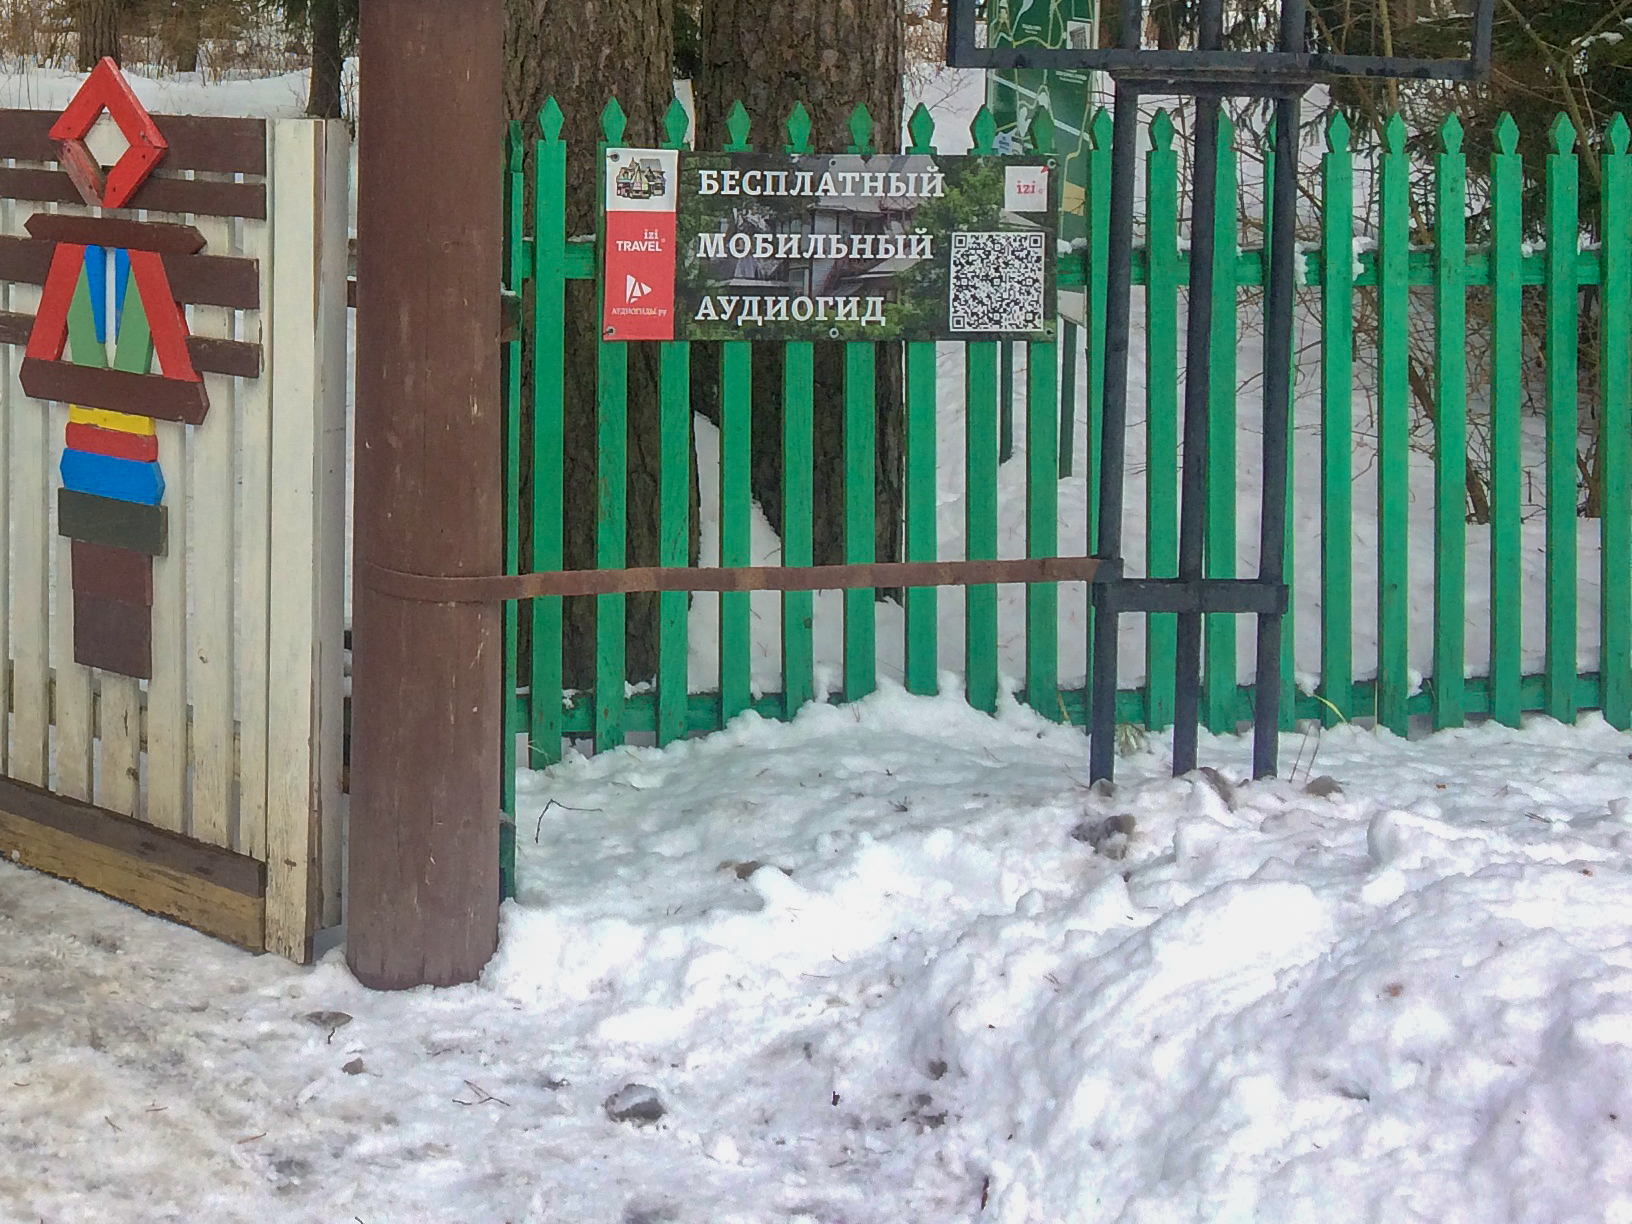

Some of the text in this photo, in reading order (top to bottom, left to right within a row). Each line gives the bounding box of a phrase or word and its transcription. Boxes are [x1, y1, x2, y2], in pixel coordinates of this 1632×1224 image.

[698, 166, 945, 197] БЕСПЛАТНЫЙ
[616, 240, 662, 252] TRAVEL
[696, 228, 934, 259] МОБИЛЬНЫЙ
[695, 296, 886, 326] АУДИОГИД
